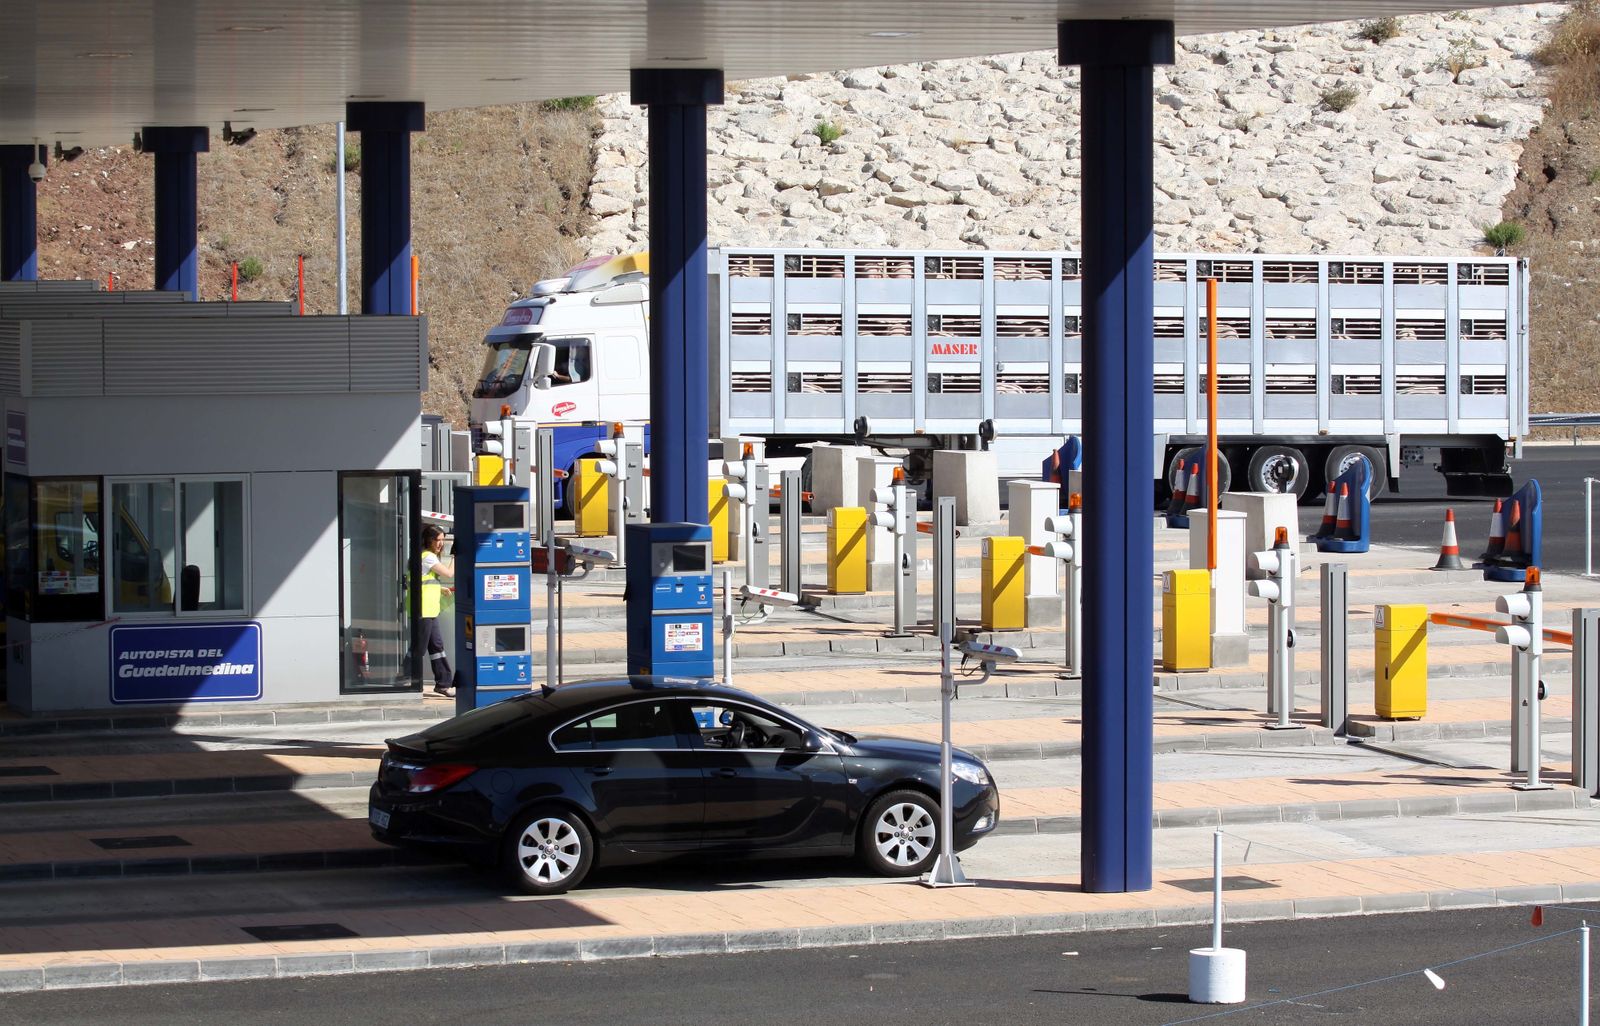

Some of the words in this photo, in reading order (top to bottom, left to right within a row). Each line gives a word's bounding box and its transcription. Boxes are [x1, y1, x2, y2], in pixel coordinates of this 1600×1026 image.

[931, 343, 978, 355] MASER
[119, 649, 194, 660] AUTOPISTA
[197, 648, 224, 658] DEL
[118, 662, 255, 678] Guadalmedina
